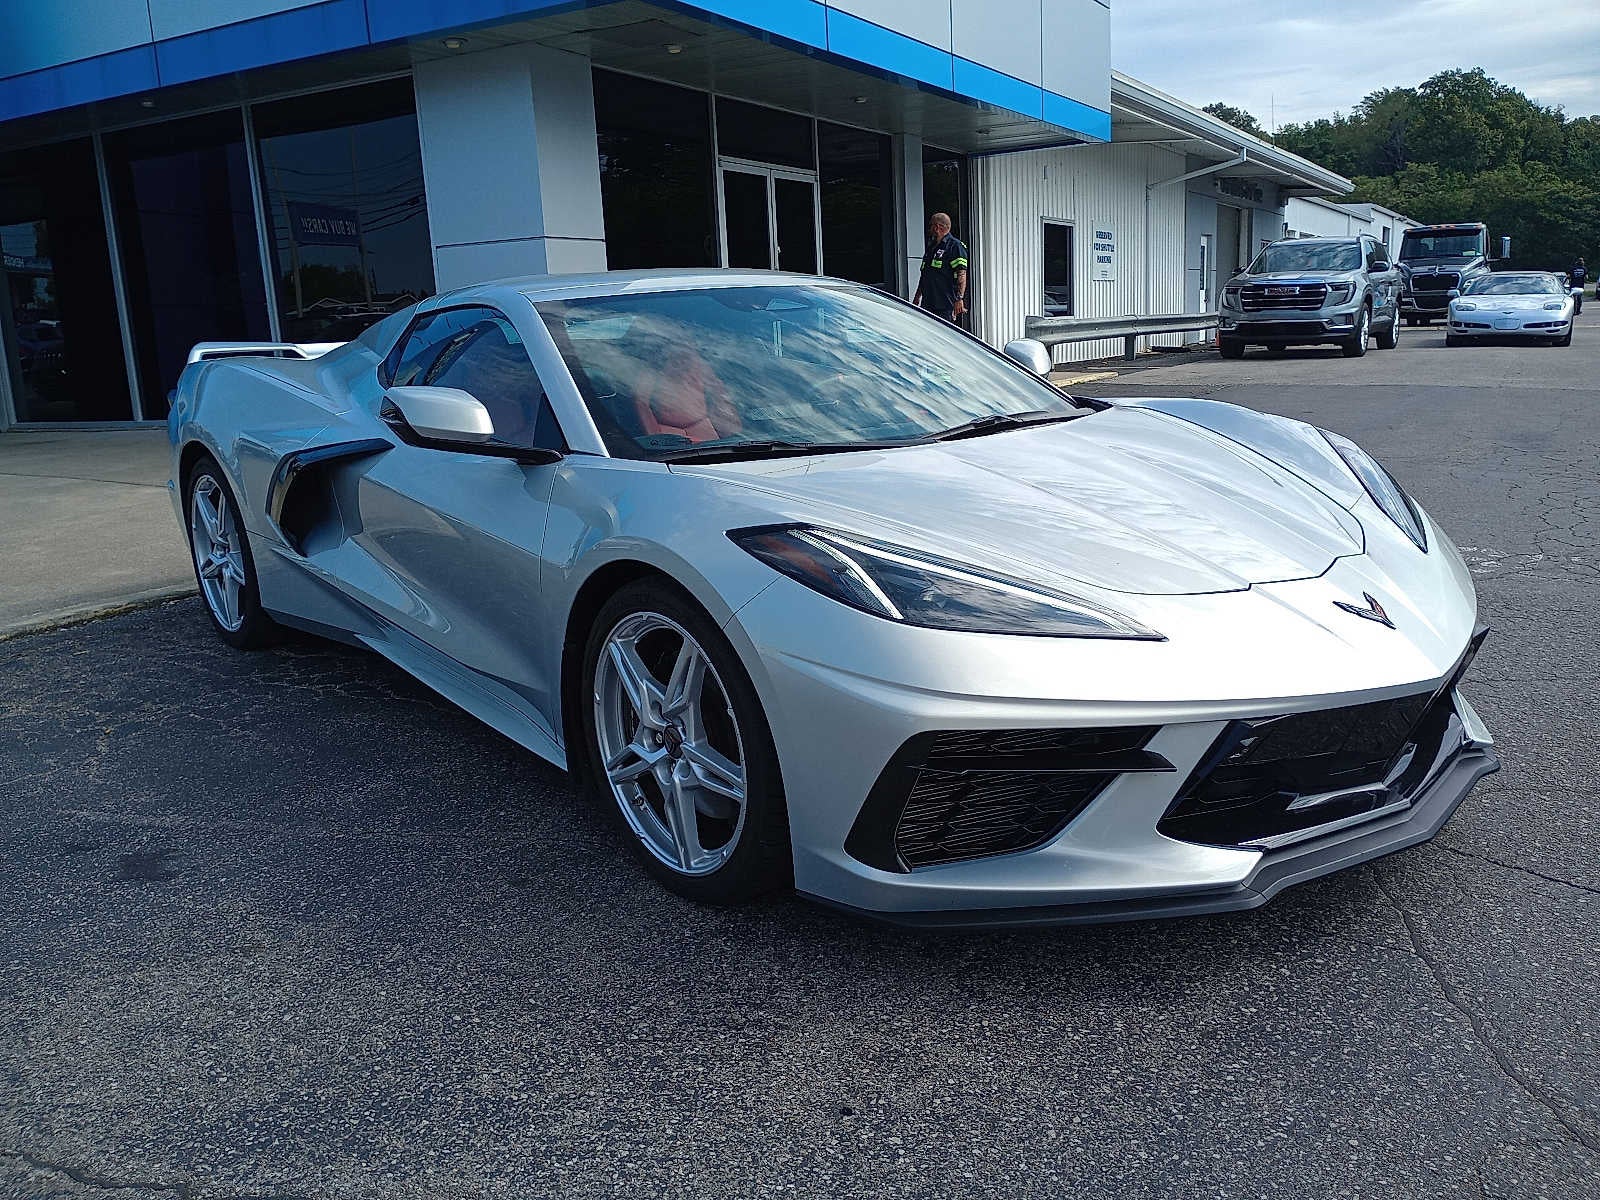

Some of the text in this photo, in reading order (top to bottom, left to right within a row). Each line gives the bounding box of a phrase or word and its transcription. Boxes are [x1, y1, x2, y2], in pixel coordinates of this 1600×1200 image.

[1095, 230, 1113, 240] RESERVED
[1101, 243, 1115, 252] SHUTTLE
[1097, 255, 1112, 264] PARKING
